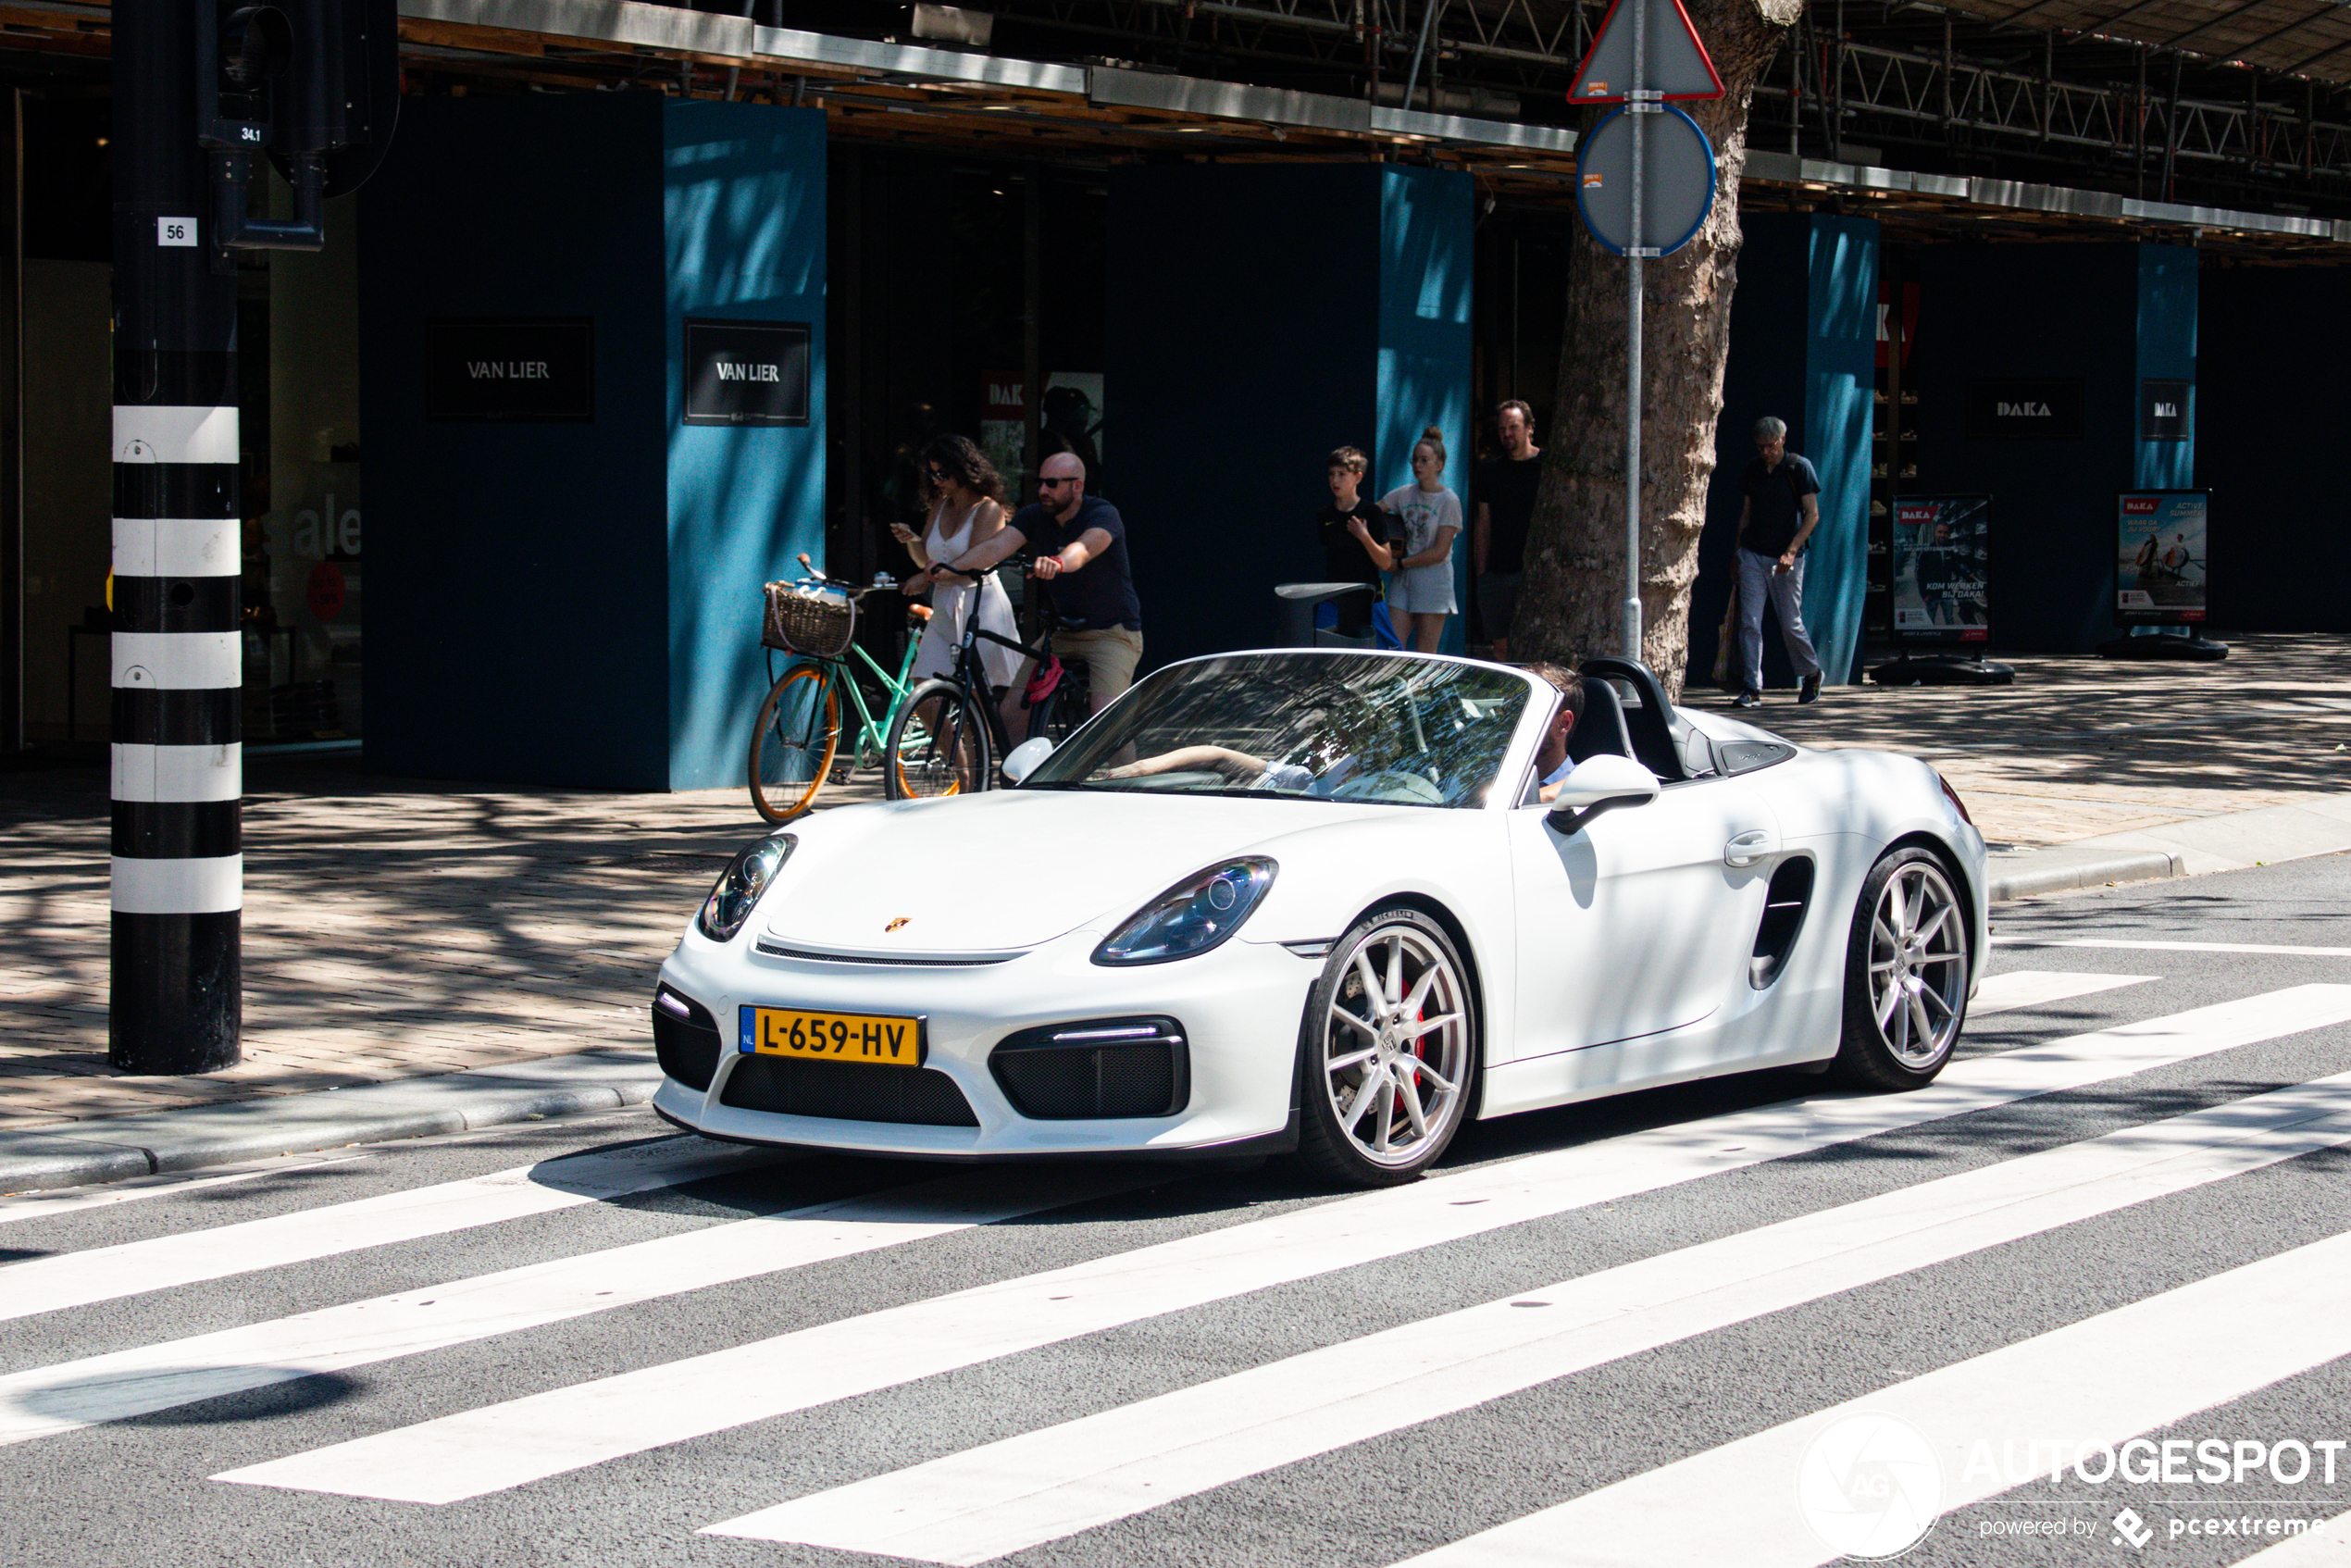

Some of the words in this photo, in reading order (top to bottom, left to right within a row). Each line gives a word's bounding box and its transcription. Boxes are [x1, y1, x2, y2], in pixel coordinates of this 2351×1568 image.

[242, 127, 261, 142] 34.1
[167, 225, 184, 240] 56
[466, 361, 504, 380] VAN
[508, 361, 551, 380] LIER
[715, 362, 746, 381] VAN
[748, 363, 780, 382] LIER
[989, 383, 1025, 406] DAK
[1996, 401, 2052, 417] DAKA
[2154, 402, 2178, 417] DAKA
[2126, 502, 2154, 510] DAKA
[2176, 502, 2204, 510] ACTIVE
[1901, 511, 1931, 519] DAKA
[262, 492, 362, 557] sale
[1926, 582, 1946, 591] KOM
[1947, 581, 1984, 590] WERKEN
[1942, 590, 1957, 599] BIJ
[1957, 590, 1984, 599] DAKA!
[742, 1034, 753, 1045] NL
[764, 1014, 905, 1058] L-659-HV
